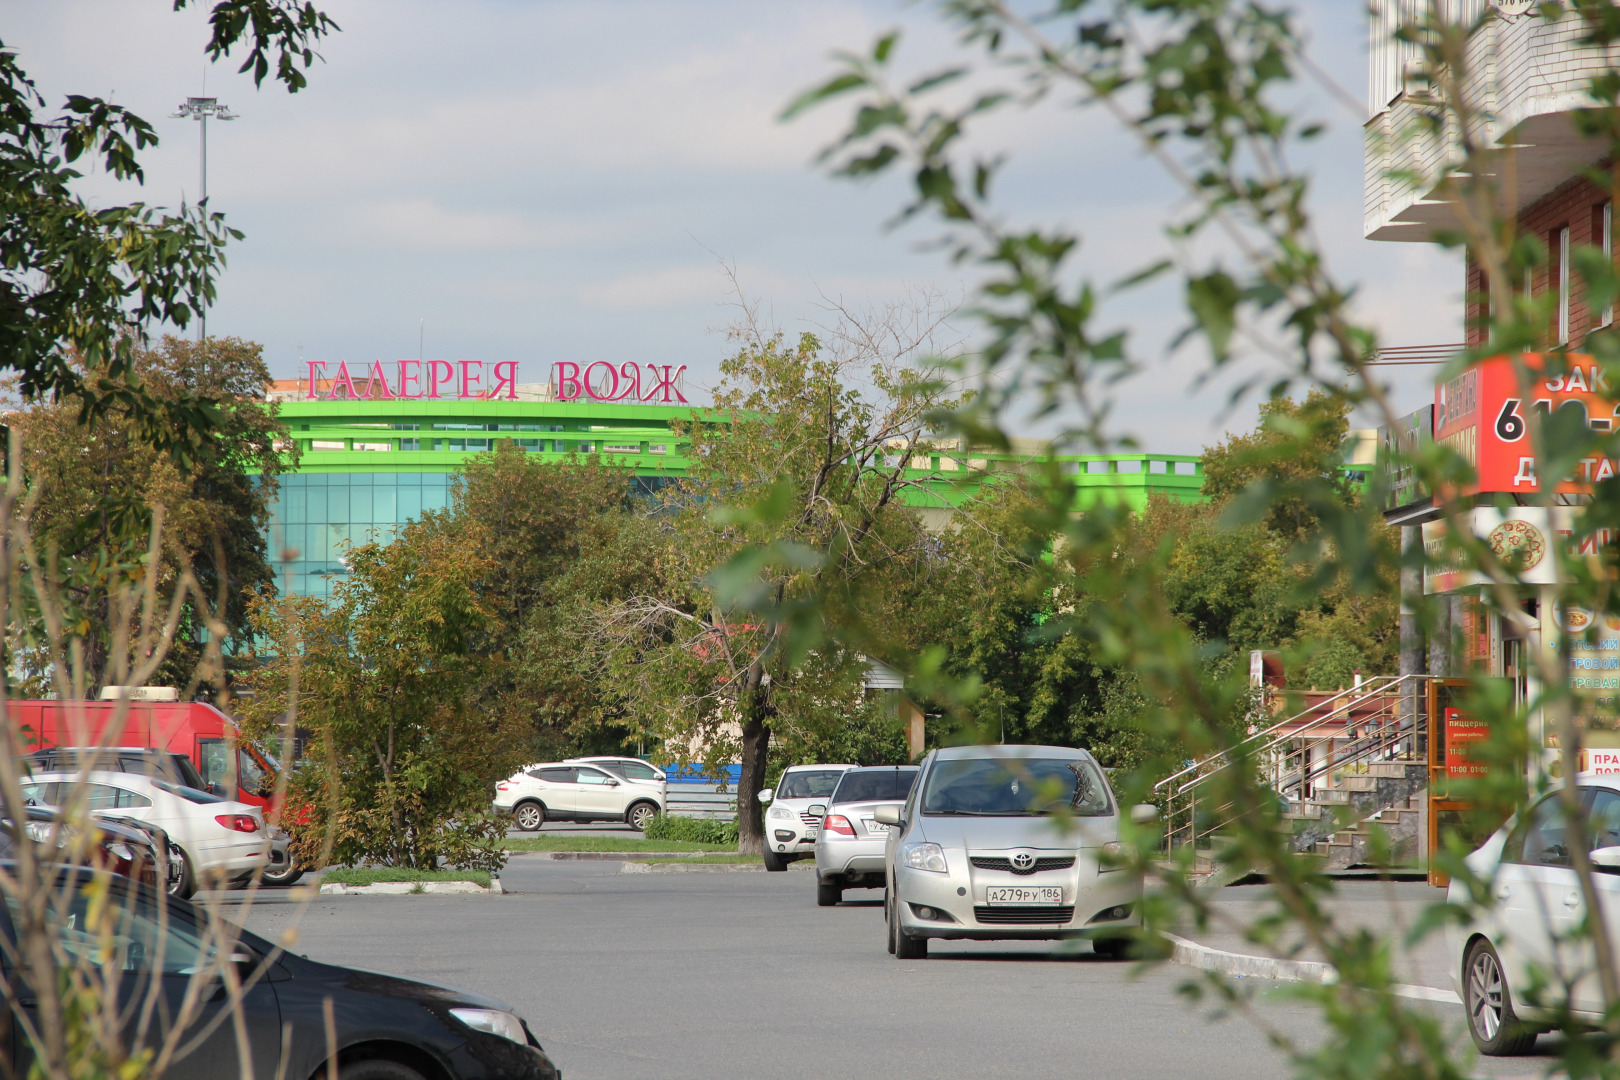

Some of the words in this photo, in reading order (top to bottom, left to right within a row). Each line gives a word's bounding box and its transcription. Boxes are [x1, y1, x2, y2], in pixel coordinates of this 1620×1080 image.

[305, 359, 520, 399] ГАЛЕРЕЯ
[554, 360, 689, 404] ВОЯЖ
[1565, 656, 1619, 669] ГРОВОЙ
[1565, 676, 1619, 689] ГРОВАЯ
[991, 888, 1038, 901] А279РУ
[1041, 888, 1059, 898] 186
